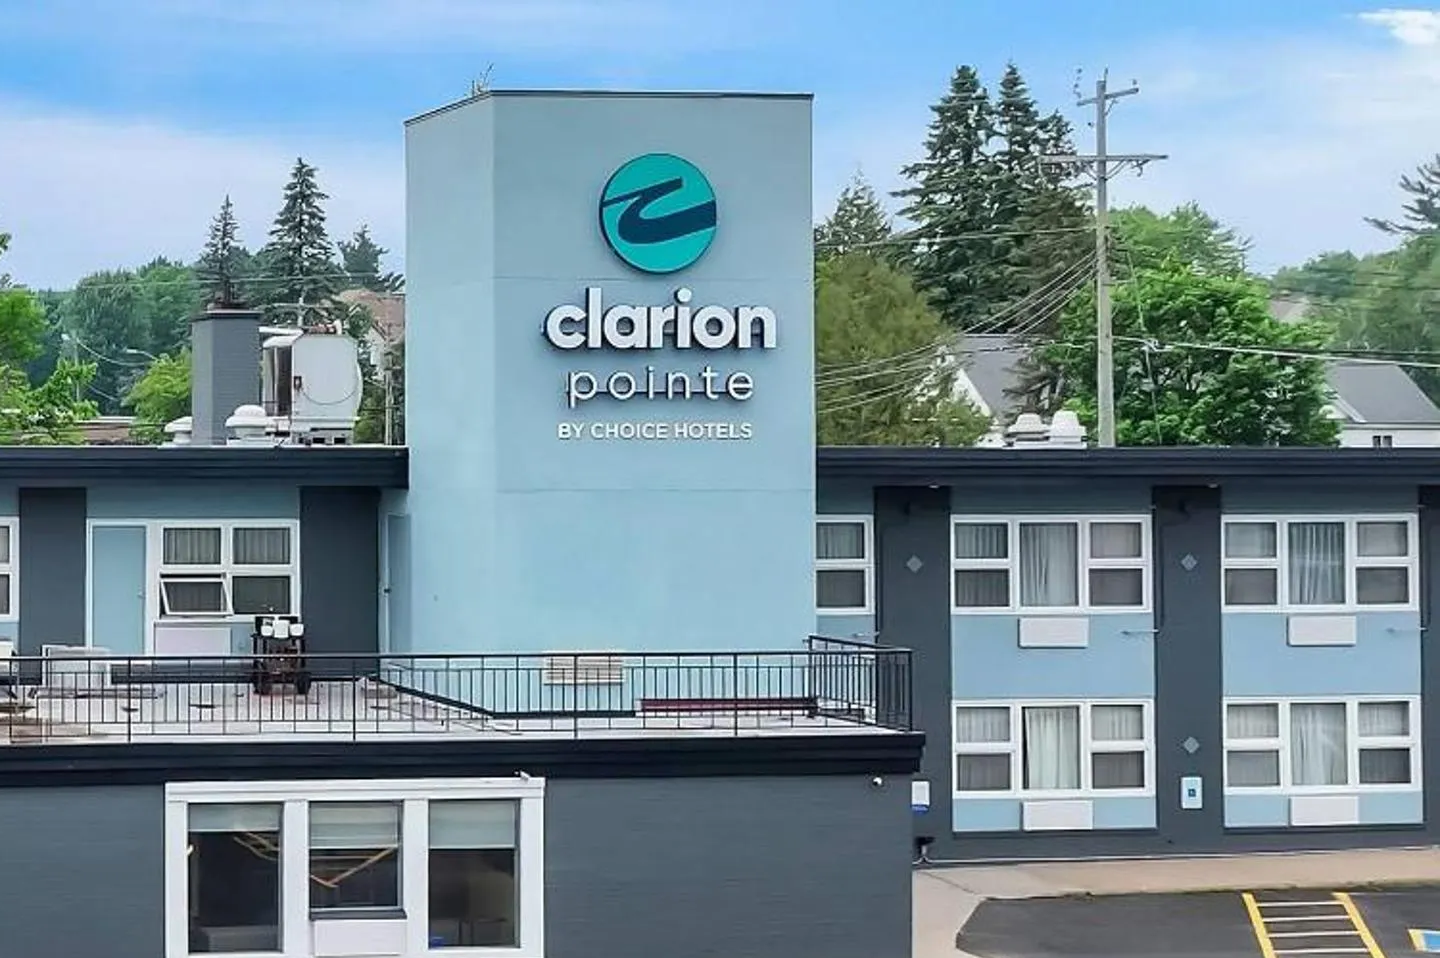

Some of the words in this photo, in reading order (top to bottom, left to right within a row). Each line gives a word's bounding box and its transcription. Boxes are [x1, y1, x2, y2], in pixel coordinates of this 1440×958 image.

[545, 287, 777, 349] clarion
[568, 366, 754, 408] pointe
[558, 423, 584, 439] BY
[591, 423, 668, 439] CHOICE
[674, 423, 753, 439] HOTELS
